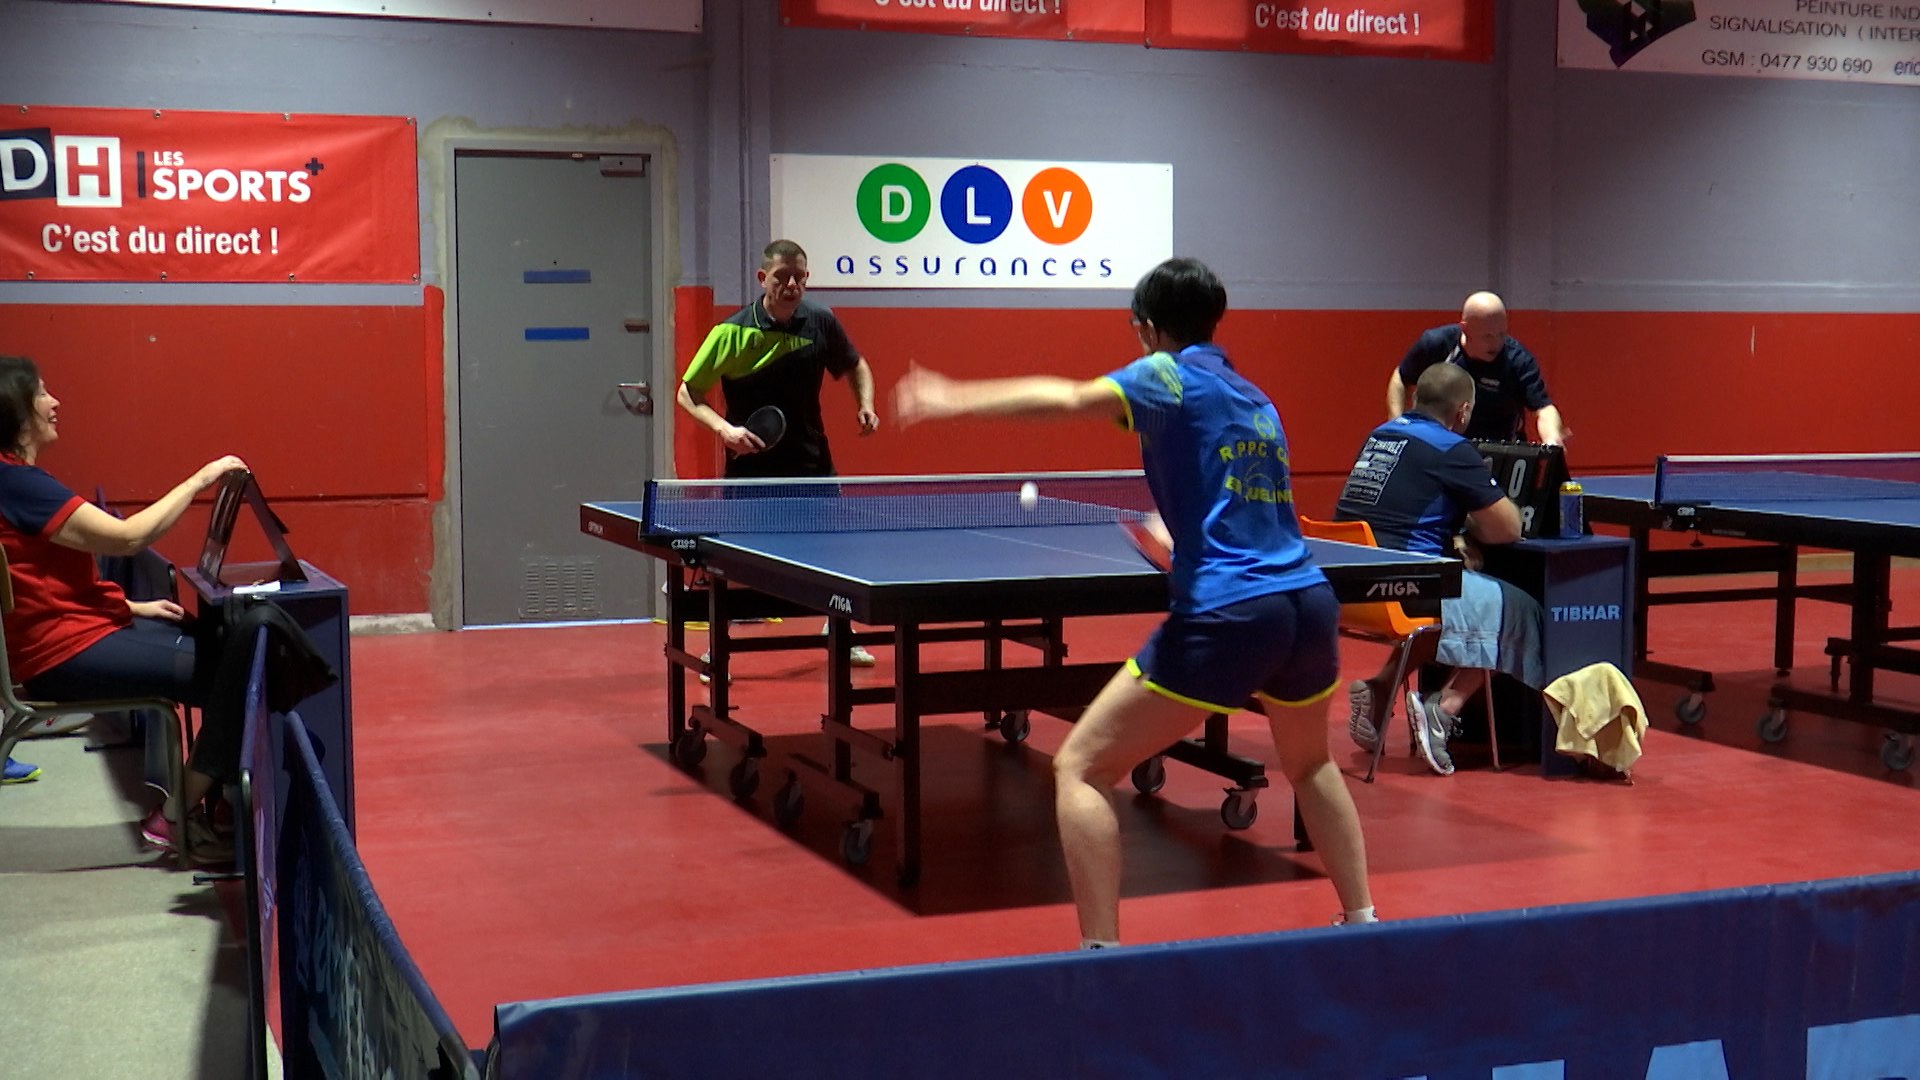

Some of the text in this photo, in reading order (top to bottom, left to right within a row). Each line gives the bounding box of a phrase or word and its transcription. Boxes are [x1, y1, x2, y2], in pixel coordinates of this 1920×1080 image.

[1255, 3, 1420, 36] C'est du direct !
[1796, 0, 1884, 19] PEINTURE
[1709, 15, 1847, 38] SIGNALISATION
[1702, 49, 1745, 66] GSM
[1760, 53, 1802, 70] 0477
[1807, 56, 1838, 72] 930
[1843, 58, 1873, 74] 690
[153, 151, 185, 166] LES
[42, 223, 278, 255] C'est du direct !
[836, 255, 1113, 278] assurances
[1366, 581, 1420, 598] STIGA
[1551, 604, 1620, 622] TIBHAR
